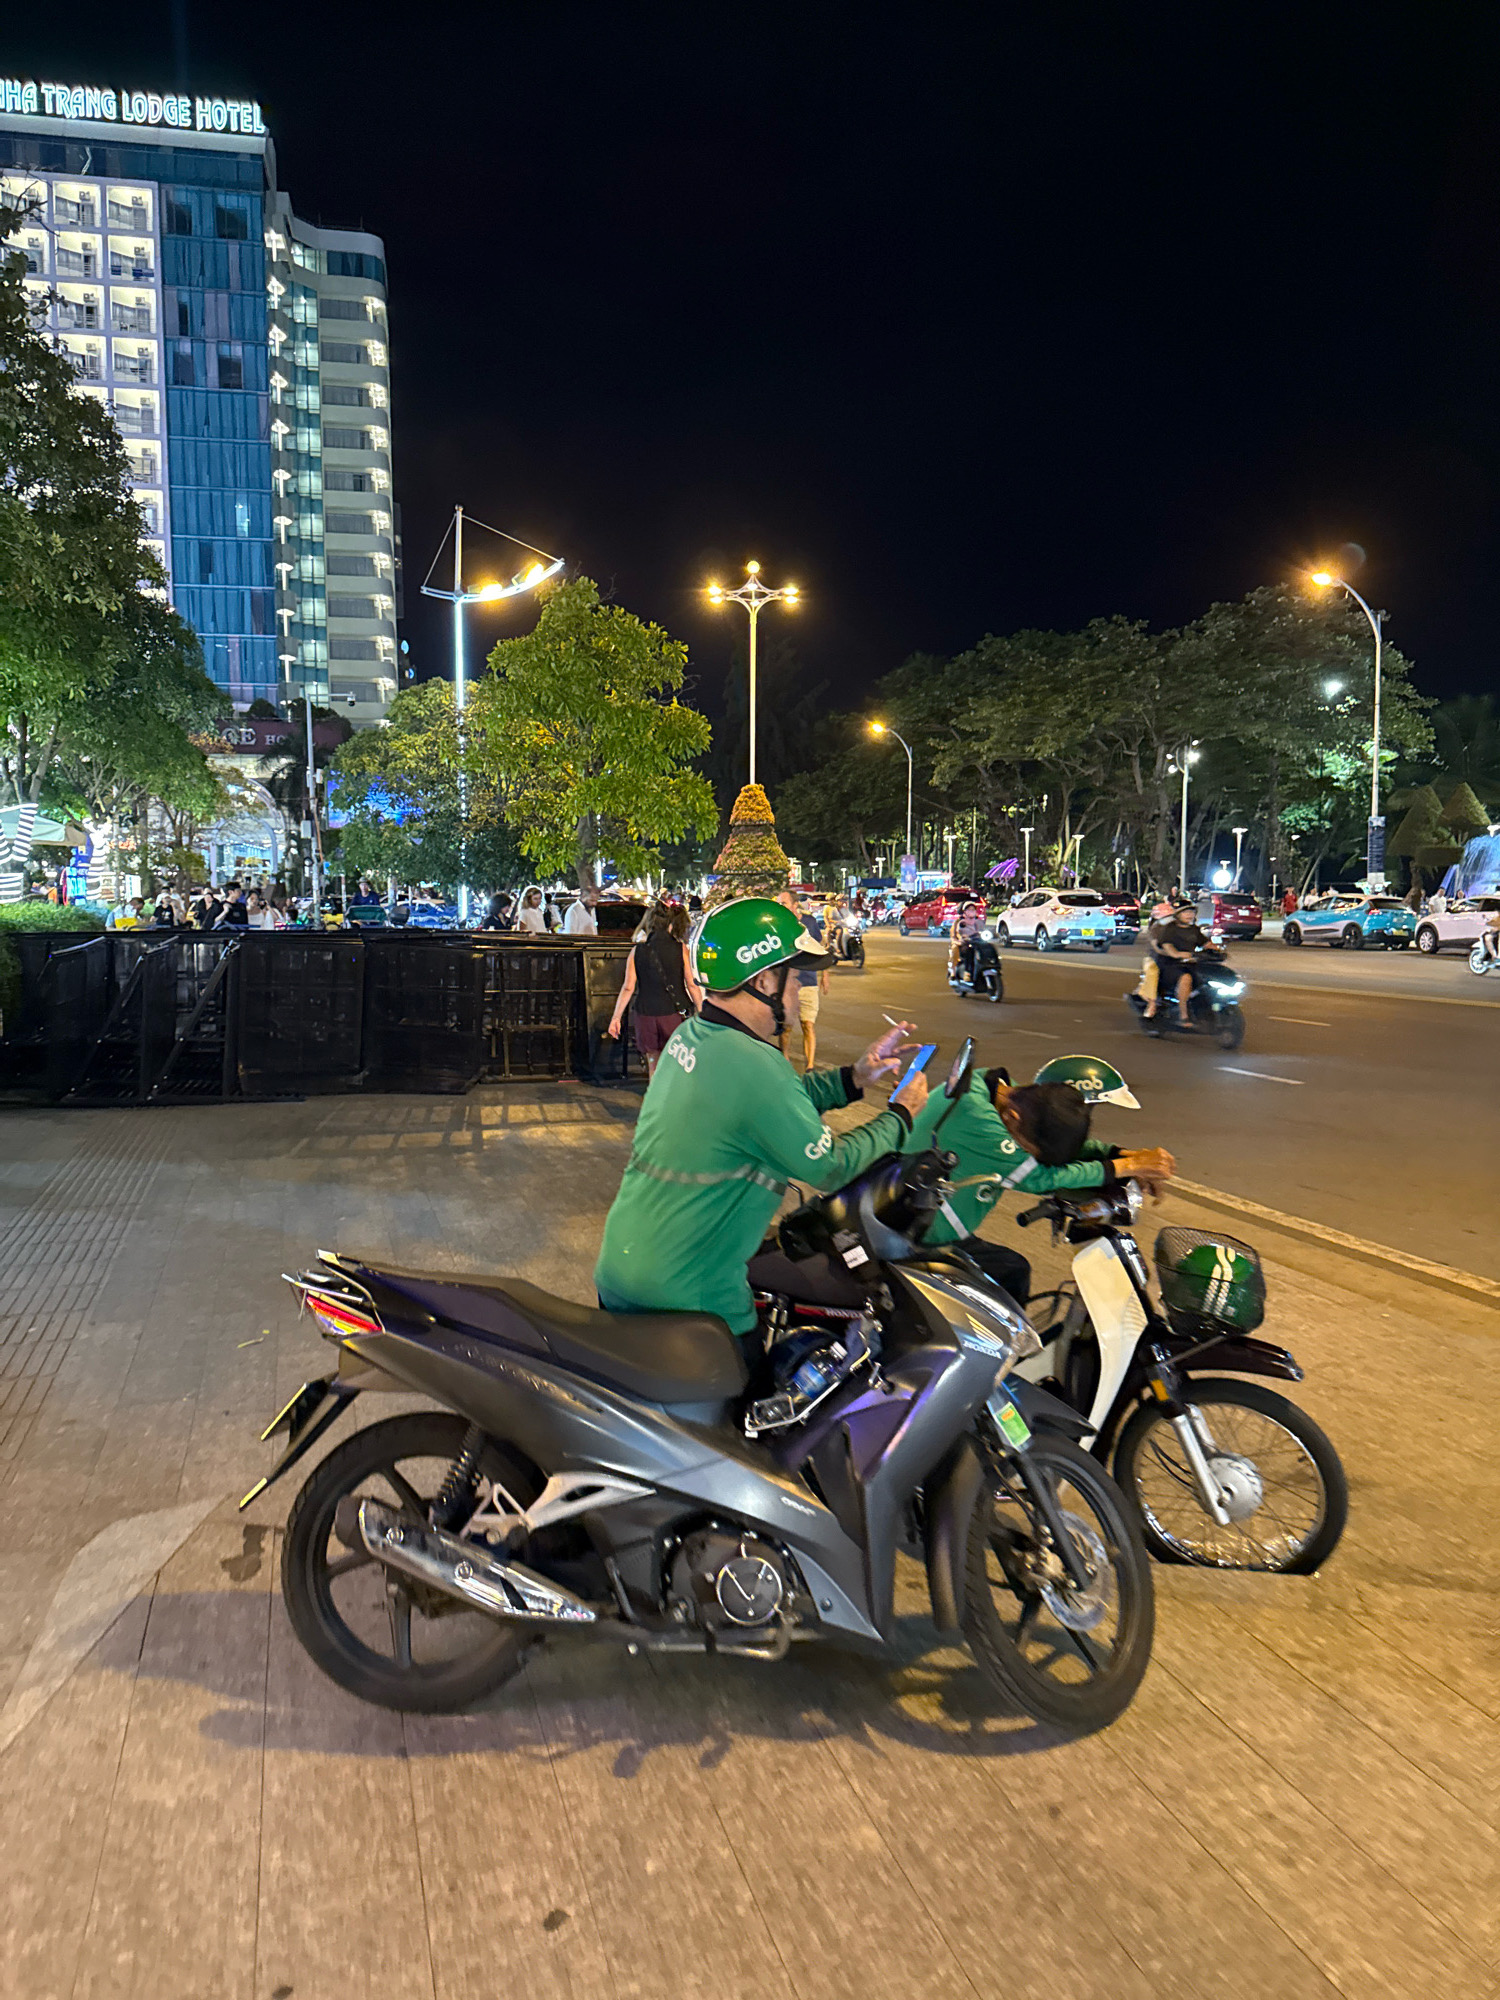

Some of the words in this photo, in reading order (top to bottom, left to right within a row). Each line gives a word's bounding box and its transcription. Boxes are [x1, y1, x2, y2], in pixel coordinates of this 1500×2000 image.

[40, 82, 117, 120] TRANG
[121, 91, 192, 128] LODGE
[195, 97, 266, 134] HOTEL
[736, 933, 782, 963] Grab
[667, 1034, 697, 1073] Grab
[963, 1339, 1003, 1360] HONDA
